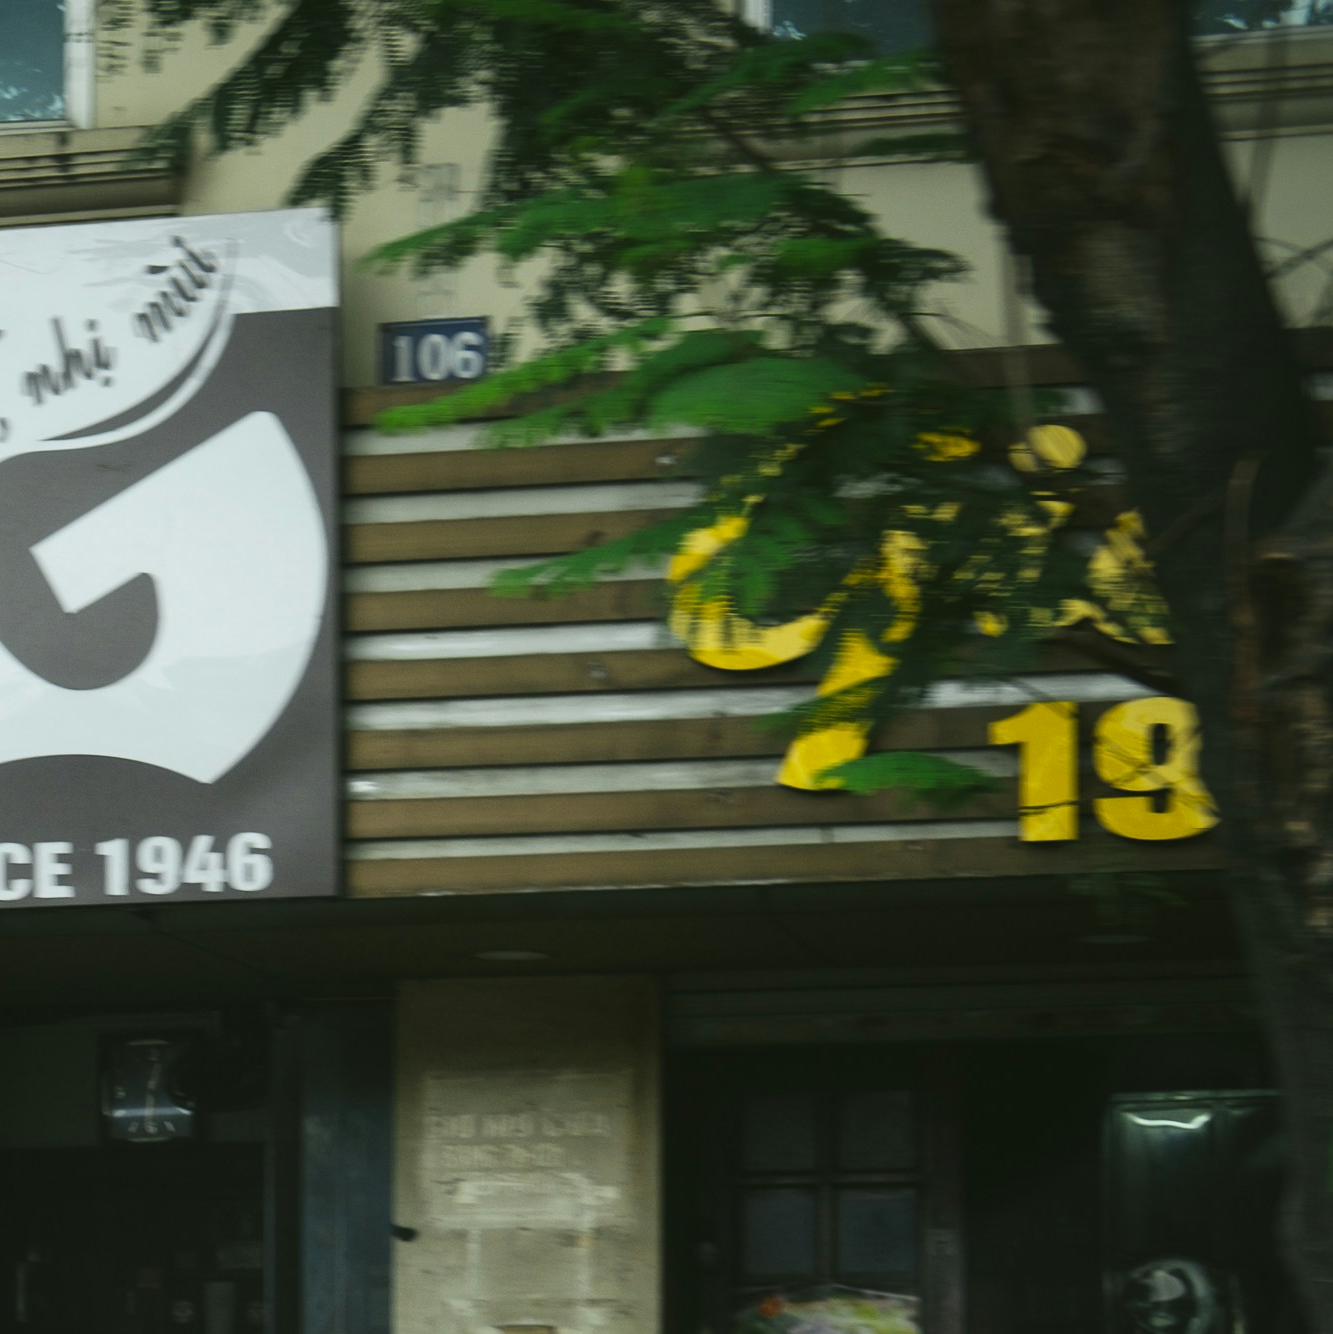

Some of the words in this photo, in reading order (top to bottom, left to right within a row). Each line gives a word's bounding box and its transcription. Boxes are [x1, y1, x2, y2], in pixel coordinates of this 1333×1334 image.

[20, 316, 117, 406] nhị
[391, 331, 485, 382] 106
[93, 831, 274, 895] 1946
